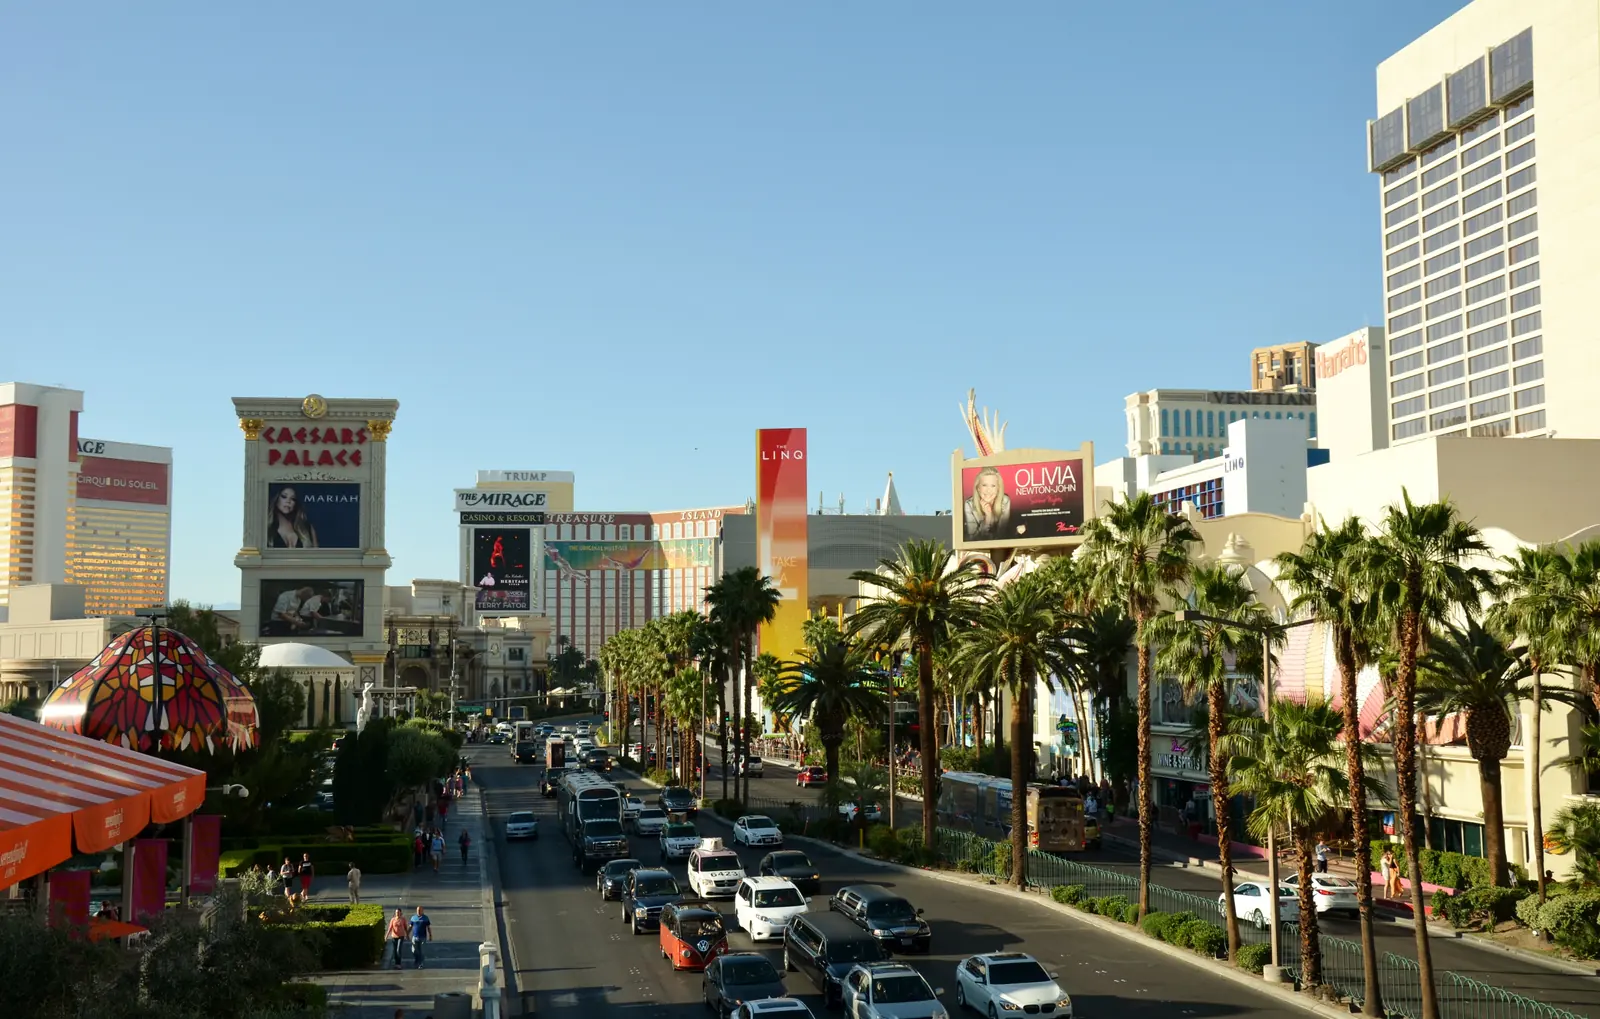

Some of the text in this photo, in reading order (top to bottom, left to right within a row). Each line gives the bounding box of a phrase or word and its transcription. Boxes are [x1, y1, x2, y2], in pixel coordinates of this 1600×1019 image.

[1213, 391, 1312, 406] VENETIAN
[262, 426, 368, 445] CAESARS
[268, 448, 362, 467] PALACE
[762, 450, 803, 460] LINQ
[504, 472, 547, 481] TRUMP
[1015, 465, 1076, 487] OLIVIA
[113, 479, 126, 487] DU
[128, 481, 159, 490] SOLEIL
[1016, 484, 1076, 495] NEWTON-JOHN
[304, 495, 359, 503] MARIAH
[459, 493, 546, 508] THE MIRAGE
[461, 514, 496, 522] CASINO
[506, 514, 541, 522] RESORT
[546, 514, 615, 523] TREASURE
[681, 510, 721, 521] ISLAND
[772, 556, 798, 567] TAKE
[780, 572, 788, 584] A
